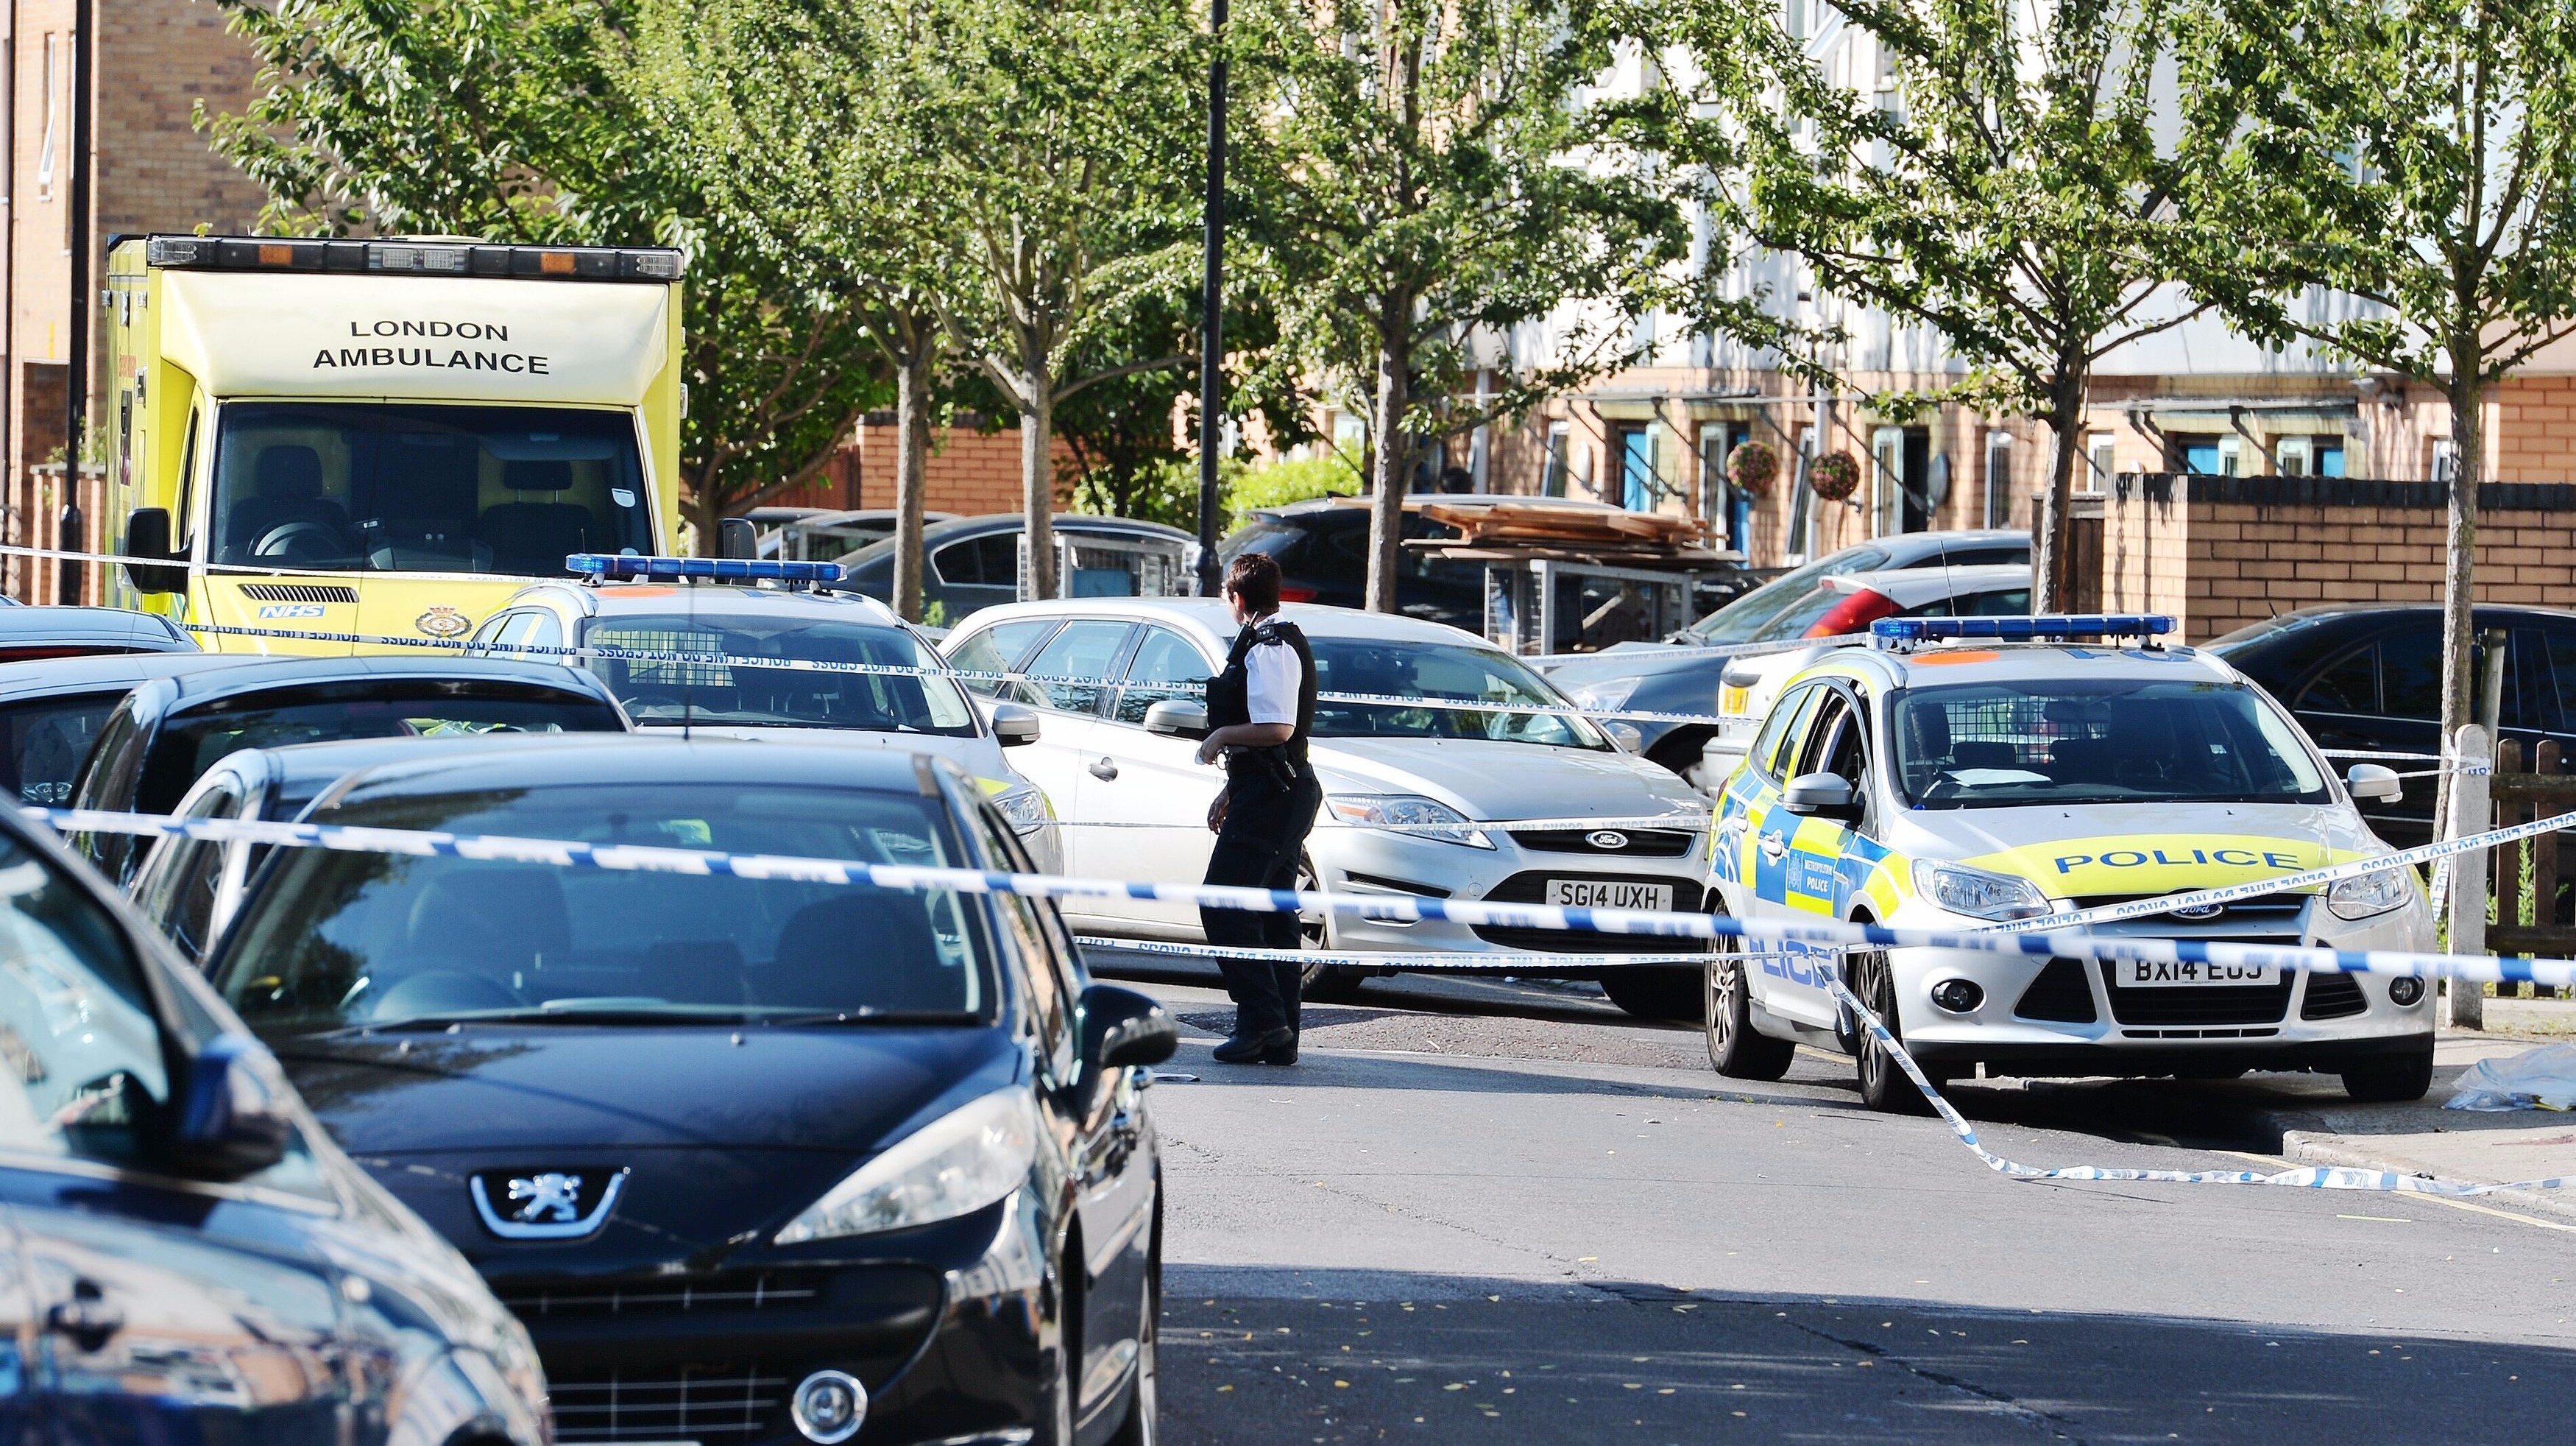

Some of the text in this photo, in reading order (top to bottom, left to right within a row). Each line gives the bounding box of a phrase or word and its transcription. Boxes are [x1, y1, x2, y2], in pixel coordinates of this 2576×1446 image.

[351, 321, 508, 341] LONDON
[314, 348, 549, 375] AMBULANCE
[260, 605, 324, 618] NHS
[1599, 835, 1618, 844] Ford
[2053, 850, 2304, 874] POLICE
[1807, 876, 1828, 892] POLICE
[1560, 884, 1657, 909] SG14 UXH
[2135, 959, 2198, 981] BX14
